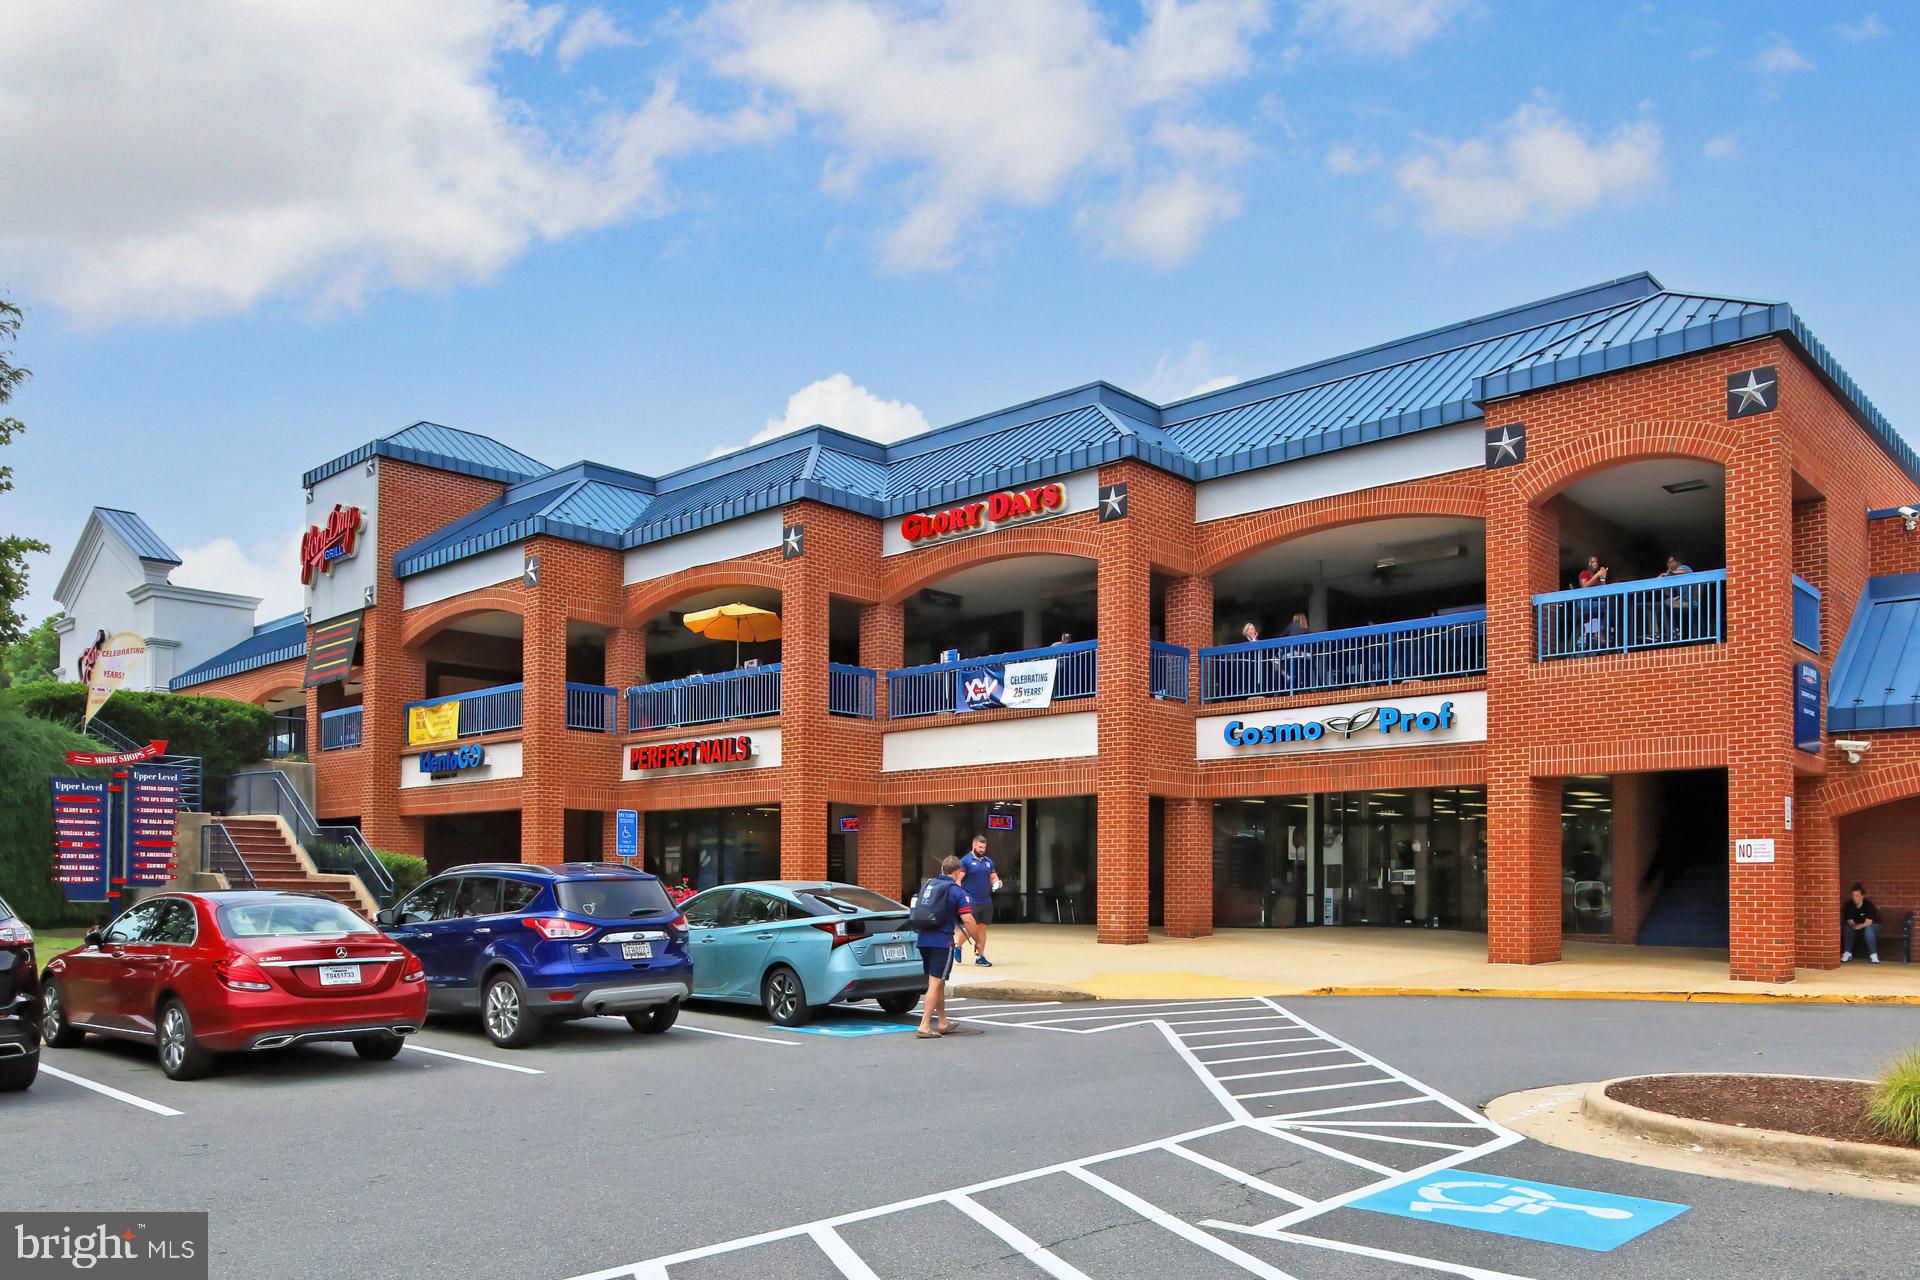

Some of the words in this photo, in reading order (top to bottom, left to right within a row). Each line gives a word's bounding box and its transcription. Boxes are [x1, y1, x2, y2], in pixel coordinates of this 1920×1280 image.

[101, 647, 145, 657] CELEBRATING
[103, 669, 125, 680] YEARS!
[1010, 672, 1048, 685] CELEBRATING
[1013, 687, 1023, 698] 25
[1023, 686, 1044, 697] YEARS!
[1224, 721, 1325, 747] Cosmo
[1379, 702, 1453, 735] Prof
[94, 756, 118, 765] MORE
[119, 751, 145, 764] SHOPS
[630, 741, 698, 770] PERFECT
[699, 735, 751, 764] NAILS
[133, 771, 157, 781] Upper
[158, 773, 178, 781] Level
[55, 781, 81, 791] Upper
[81, 783, 103, 791] Level
[1738, 843, 1753, 858] NO
